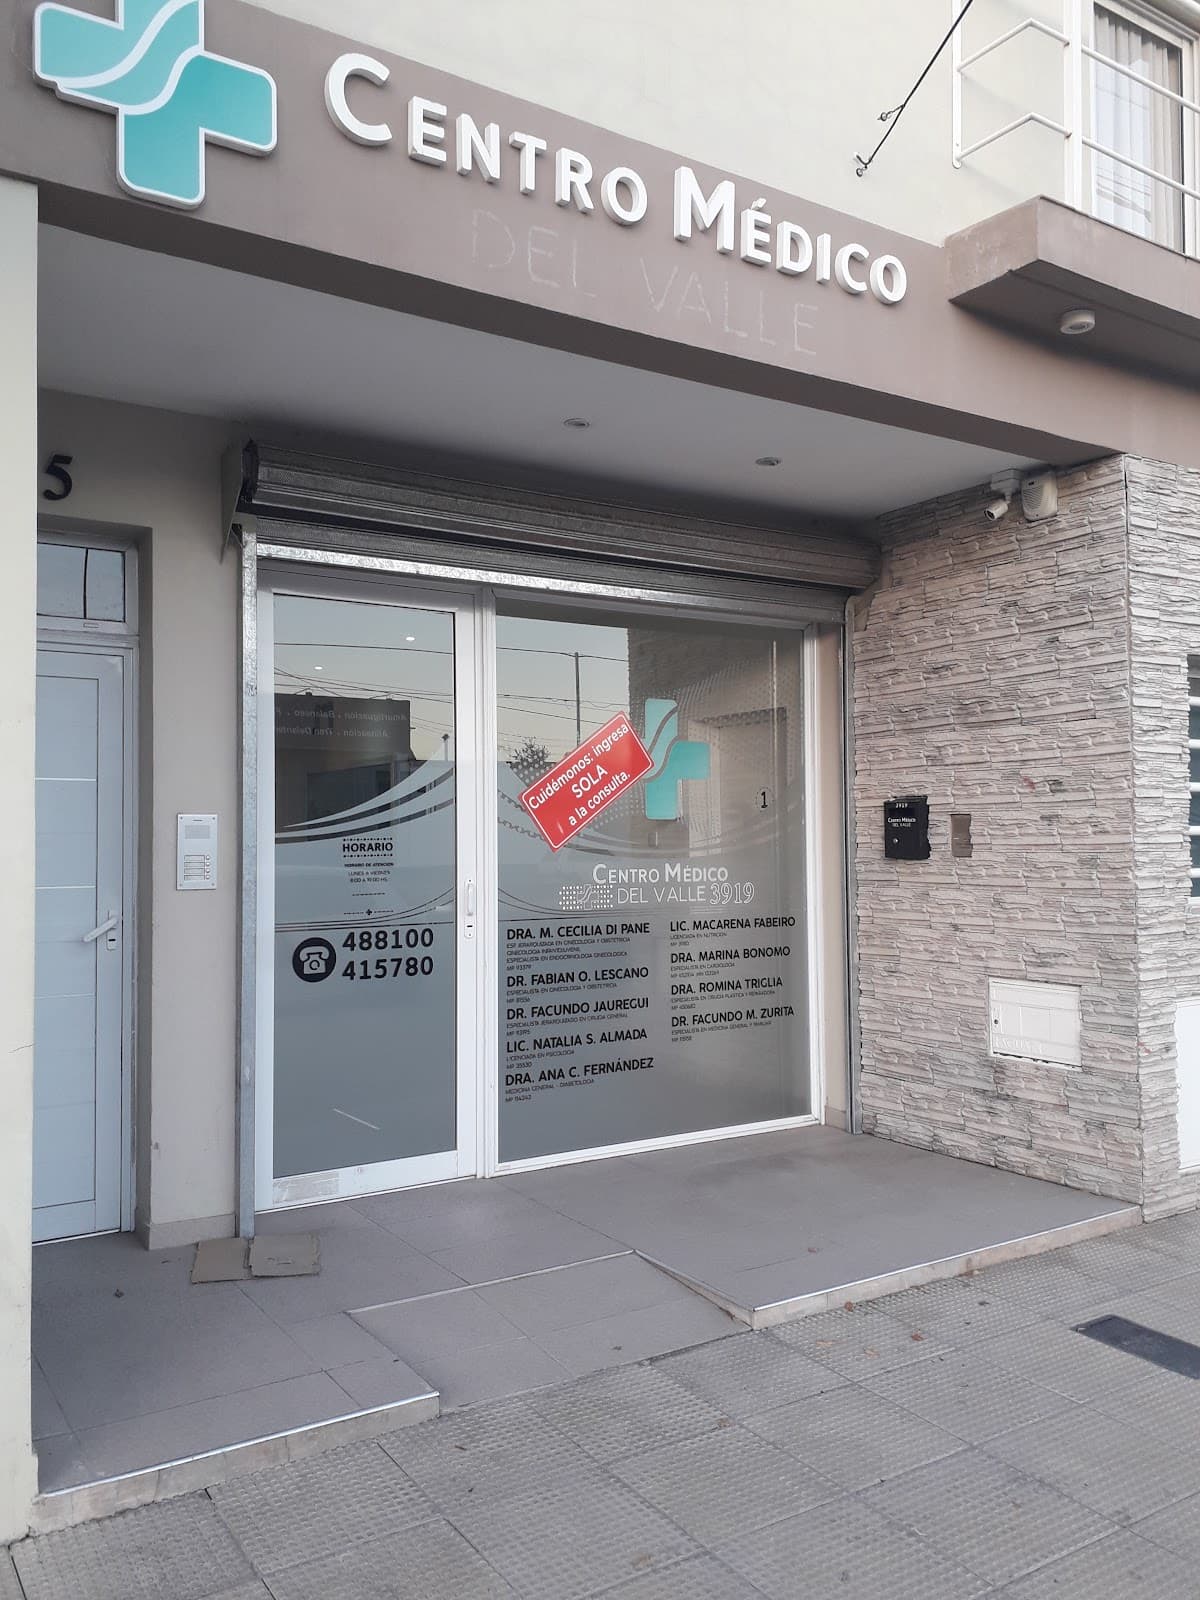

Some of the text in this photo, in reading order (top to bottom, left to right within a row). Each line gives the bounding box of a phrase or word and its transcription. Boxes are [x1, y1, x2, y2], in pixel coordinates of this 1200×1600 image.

[324, 53, 907, 306] CENTRO MÉDICO
[472, 209, 818, 356] DEL VALLE
[43, 454, 72, 500] 5
[528, 723, 629, 809] Cuidémonos: ingresa
[571, 764, 608, 798] SOLA
[568, 771, 631, 826] a la consulta.
[761, 792, 768, 808] 1
[342, 842, 394, 853] HORARIO
[592, 863, 729, 884] CENTRO MÉDICO
[617, 882, 755, 905] DEL VALLE 3919
[507, 922, 650, 940] DRA. M. CECILIA DI PANE
[670, 916, 796, 931] LIC. MACARENA FABEIRO
[342, 928, 434, 951] 488100
[671, 946, 791, 964] DRA. MARINA BONOMO
[342, 956, 434, 980] 415780
[507, 967, 649, 987] DR. FABIAN O. LESCANO
[671, 977, 783, 995] DRA. ROMINA TRIGLIA
[507, 997, 649, 1020] DR. FACUNDO JAUREGUI
[672, 1006, 794, 1027] DR. FACUNDO M. ZURITA
[507, 1028, 647, 1053] LIC. NATALIA S. ALMADA
[505, 1058, 654, 1086] DRA. ANA C. FERNÁNDEZ
